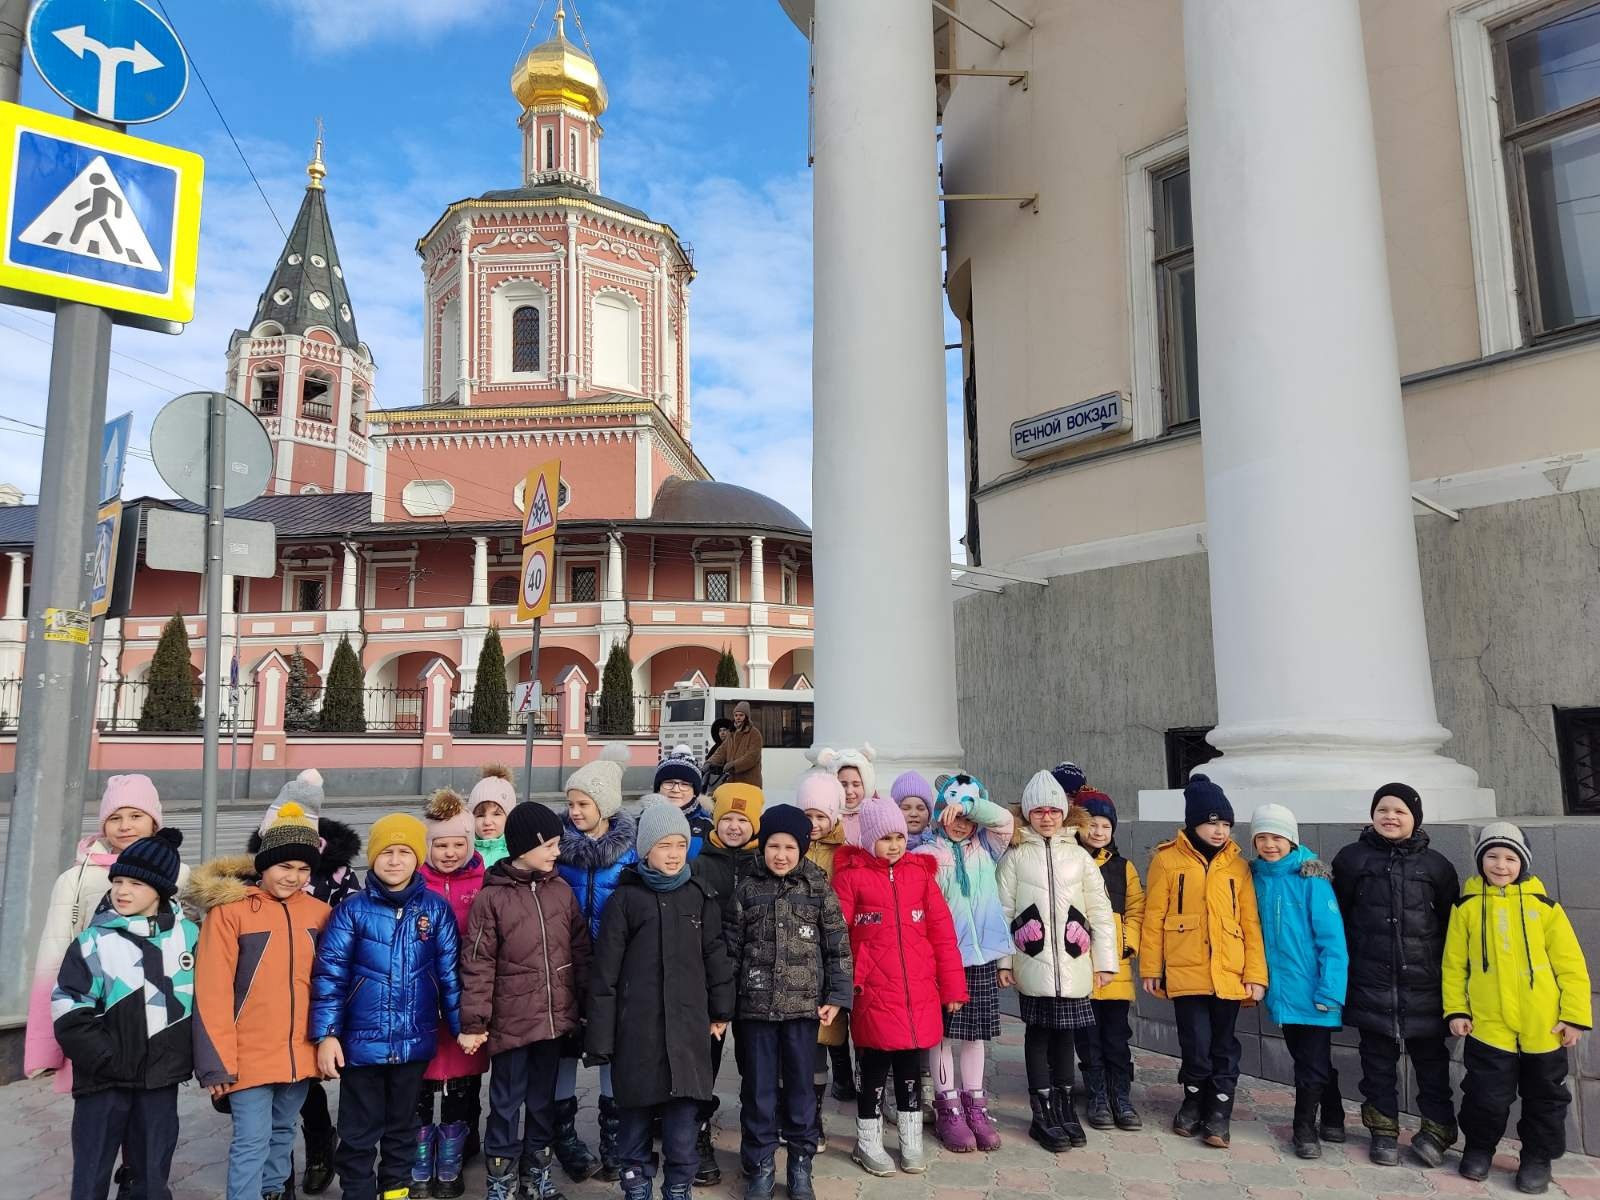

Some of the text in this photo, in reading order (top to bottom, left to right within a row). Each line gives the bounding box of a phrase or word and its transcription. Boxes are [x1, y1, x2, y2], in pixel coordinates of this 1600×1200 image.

[1014, 402, 1118, 446] РЕЧНОЙ ВОКЗАЛ
[527, 568, 542, 592] 40
